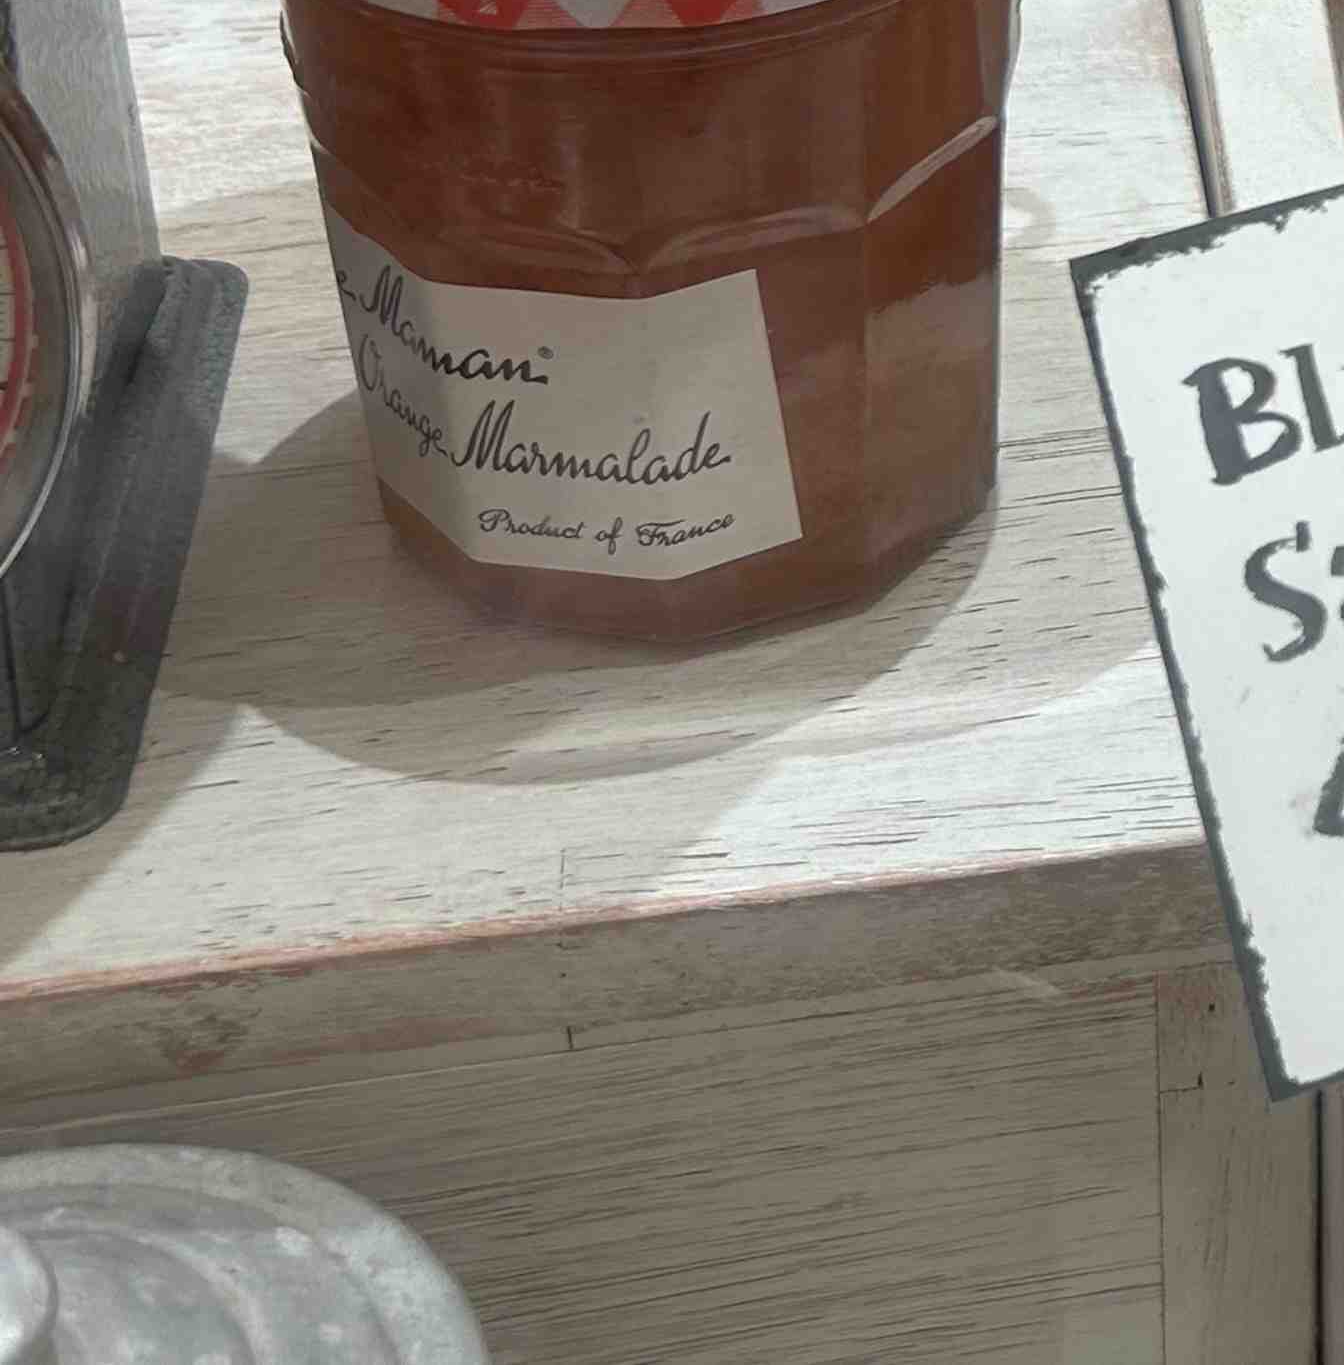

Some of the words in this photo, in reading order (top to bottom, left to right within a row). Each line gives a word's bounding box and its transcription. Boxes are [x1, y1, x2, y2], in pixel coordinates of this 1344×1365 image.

[358, 334, 449, 458] Orange
[451, 400, 731, 486] Marmalade
[478, 508, 584, 541] Product
[594, 517, 623, 555] of
[636, 512, 737, 548] France
